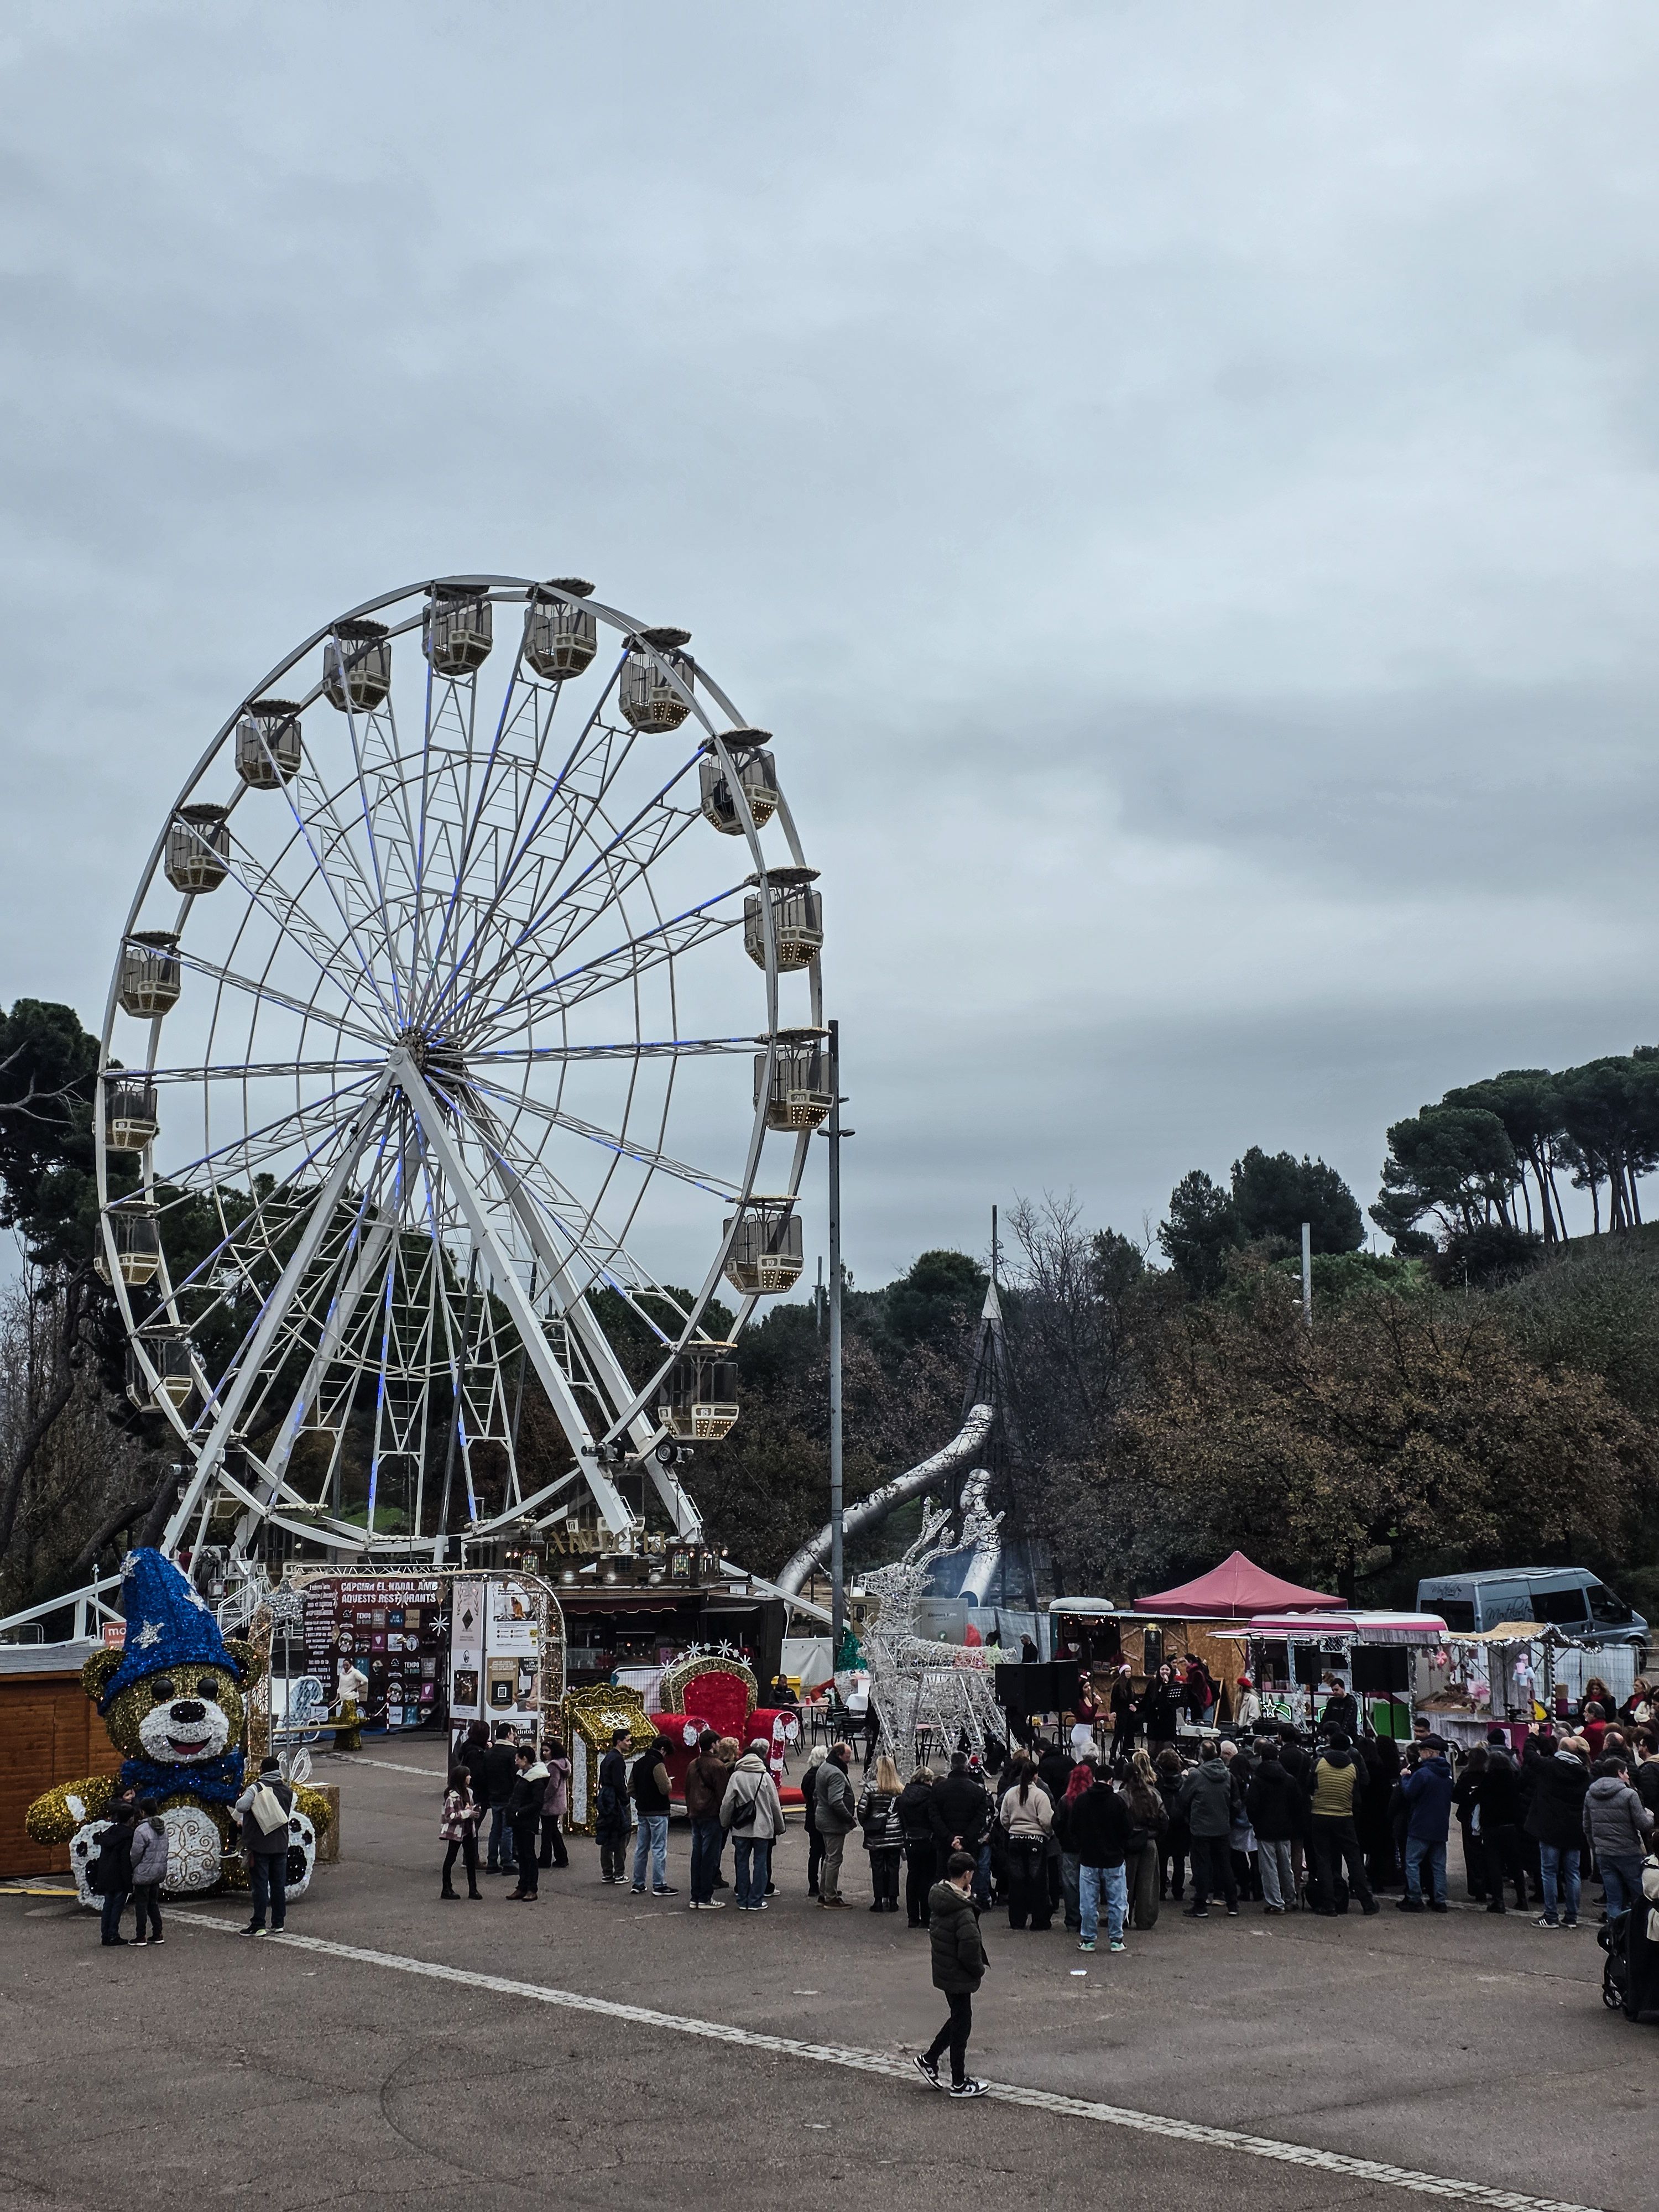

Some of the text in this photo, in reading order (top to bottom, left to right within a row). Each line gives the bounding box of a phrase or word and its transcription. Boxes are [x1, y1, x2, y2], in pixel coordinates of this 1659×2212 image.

[377, 1582, 386, 1590] EL
[388, 1582, 415, 1590] NADAL
[418, 1581, 438, 1590] AMB
[341, 1594, 376, 1603] AQUESTS
